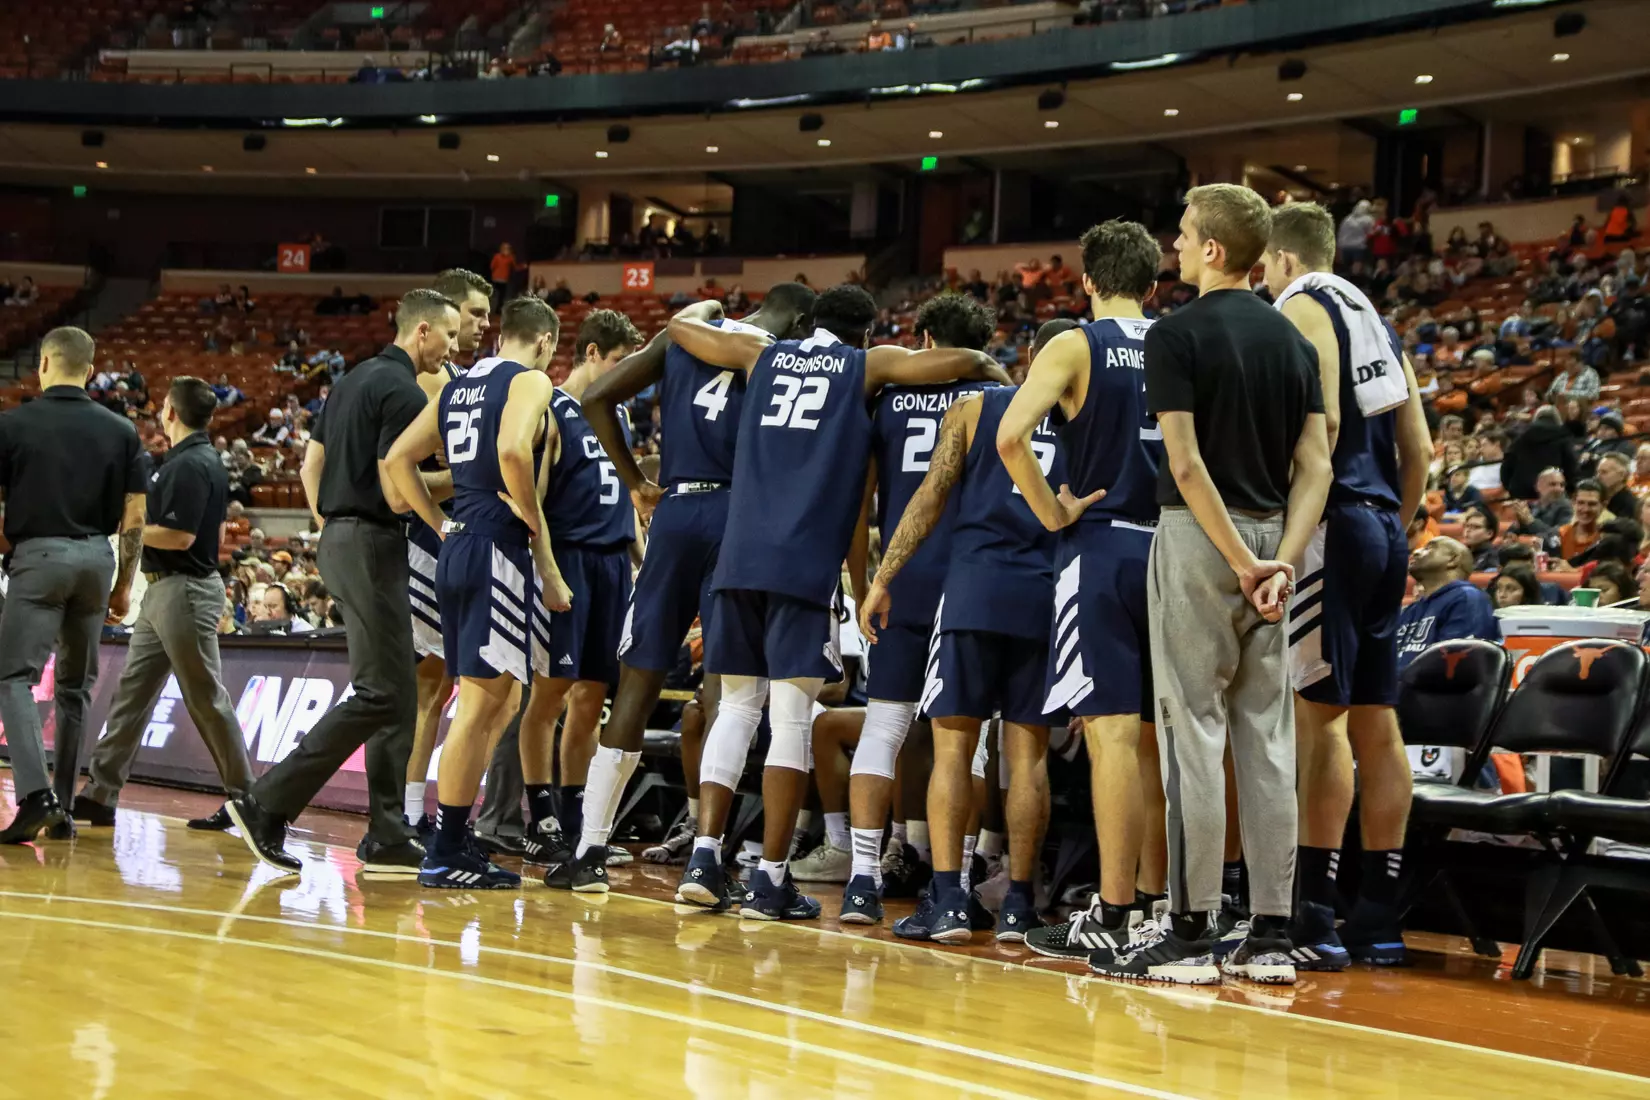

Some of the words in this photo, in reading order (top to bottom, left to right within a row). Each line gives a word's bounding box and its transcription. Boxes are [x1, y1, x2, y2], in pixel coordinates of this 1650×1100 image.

[282, 249, 305, 267] 24
[627, 268, 650, 287] 23
[771, 352, 845, 375] ROBINSON
[693, 370, 735, 421] 4
[760, 374, 830, 430] 32
[446, 408, 482, 464] 25
[599, 461, 620, 505] 5
